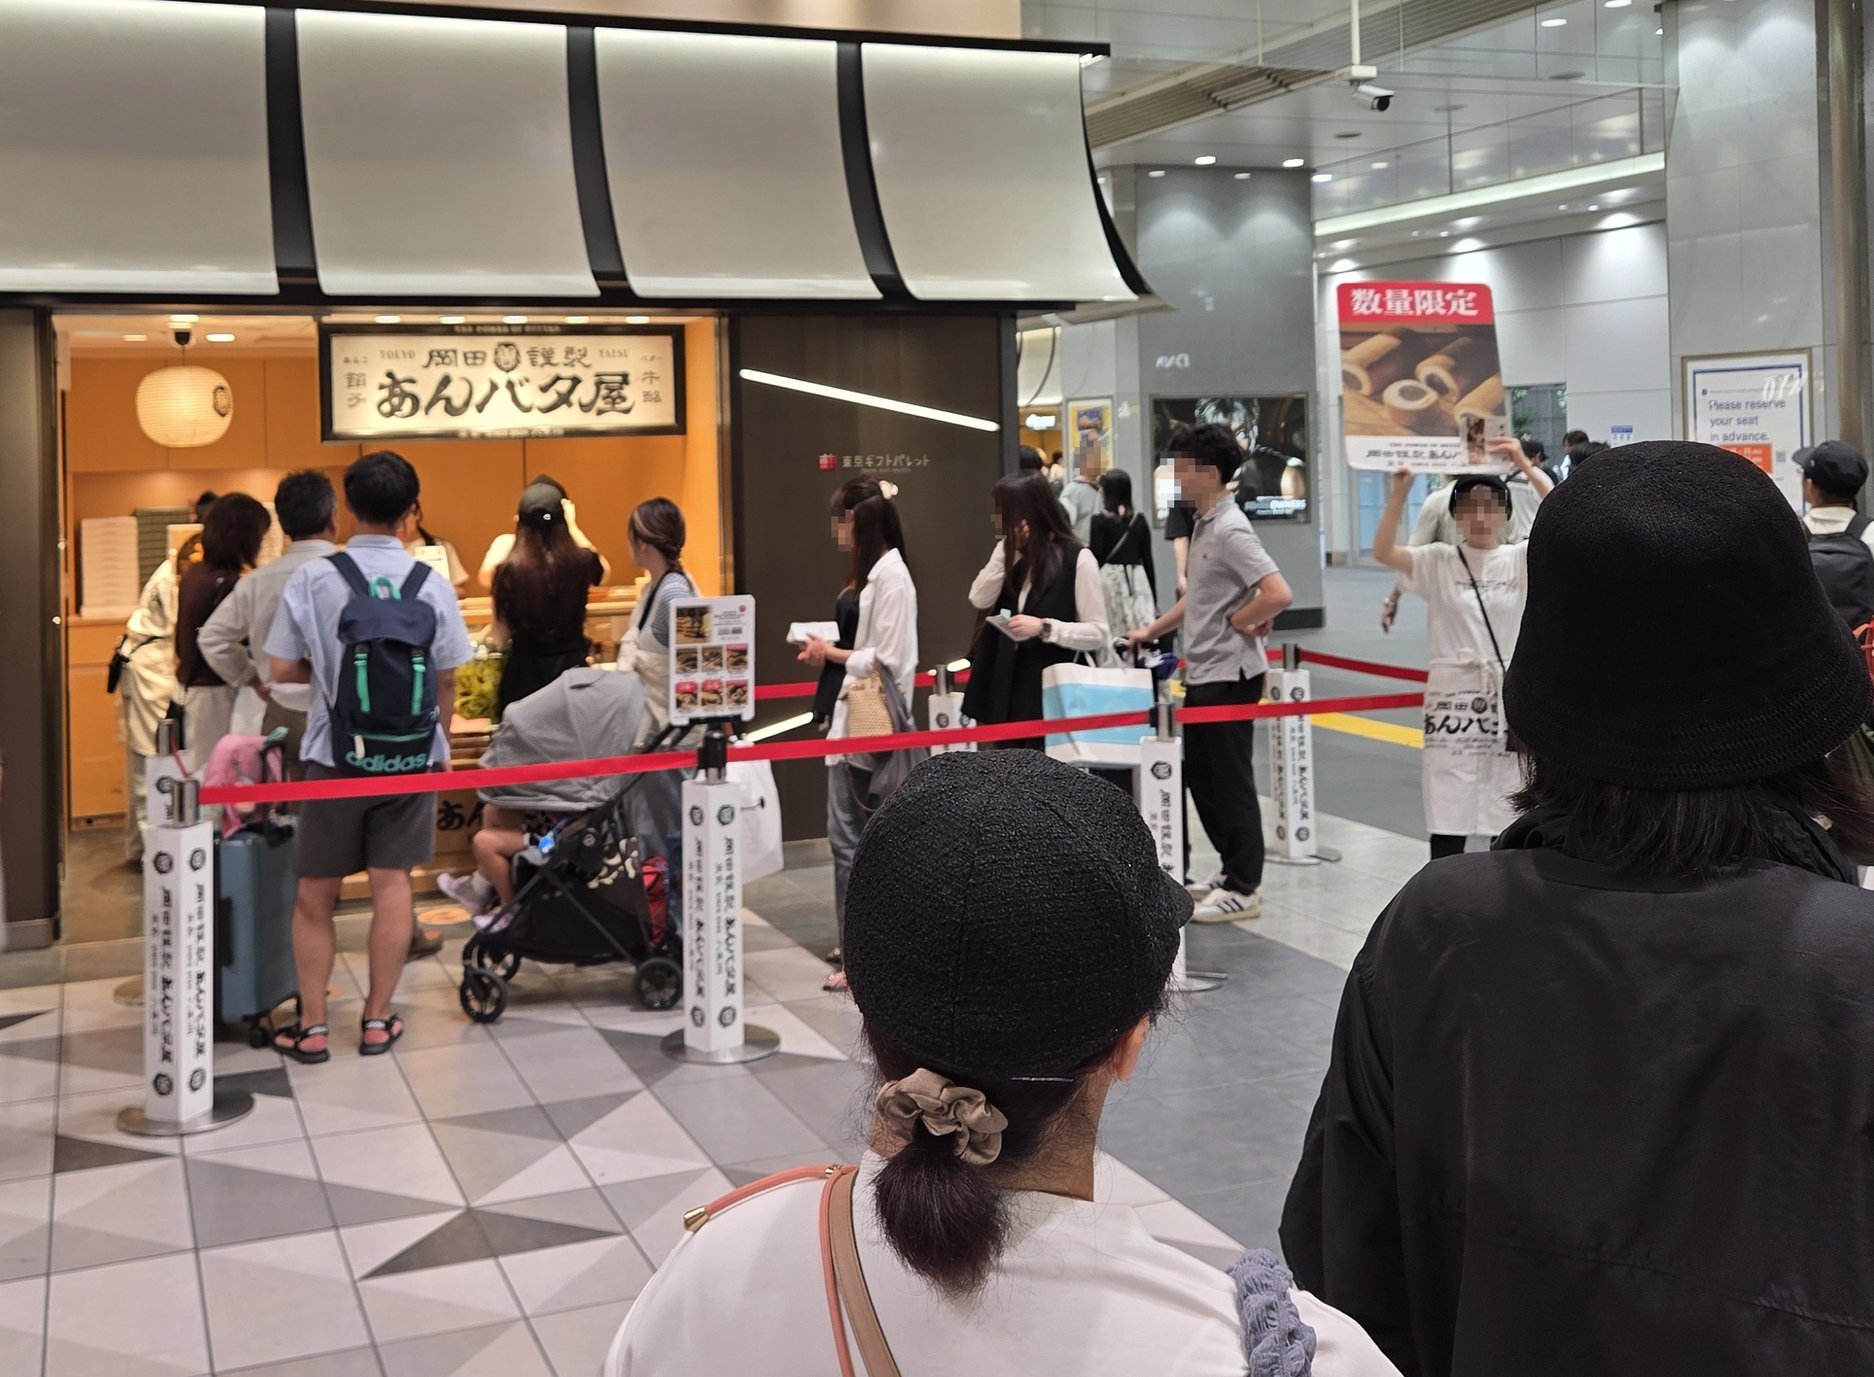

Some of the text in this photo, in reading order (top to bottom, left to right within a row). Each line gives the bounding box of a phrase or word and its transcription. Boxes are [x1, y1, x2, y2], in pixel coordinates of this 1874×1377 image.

[1350, 288, 1479, 316] 数量限定
[379, 349, 416, 360] TOKYO
[422, 348, 488, 369] 岡田
[599, 348, 630, 359] YAESU
[376, 369, 635, 419] あんバタ屋
[1708, 399, 1786, 411] Please reserve
[1710, 415, 1759, 428] your seat
[1710, 431, 1719, 441] in
[842, 453, 930, 468] 東京ギフトパレット
[345, 750, 427, 772] adidas
